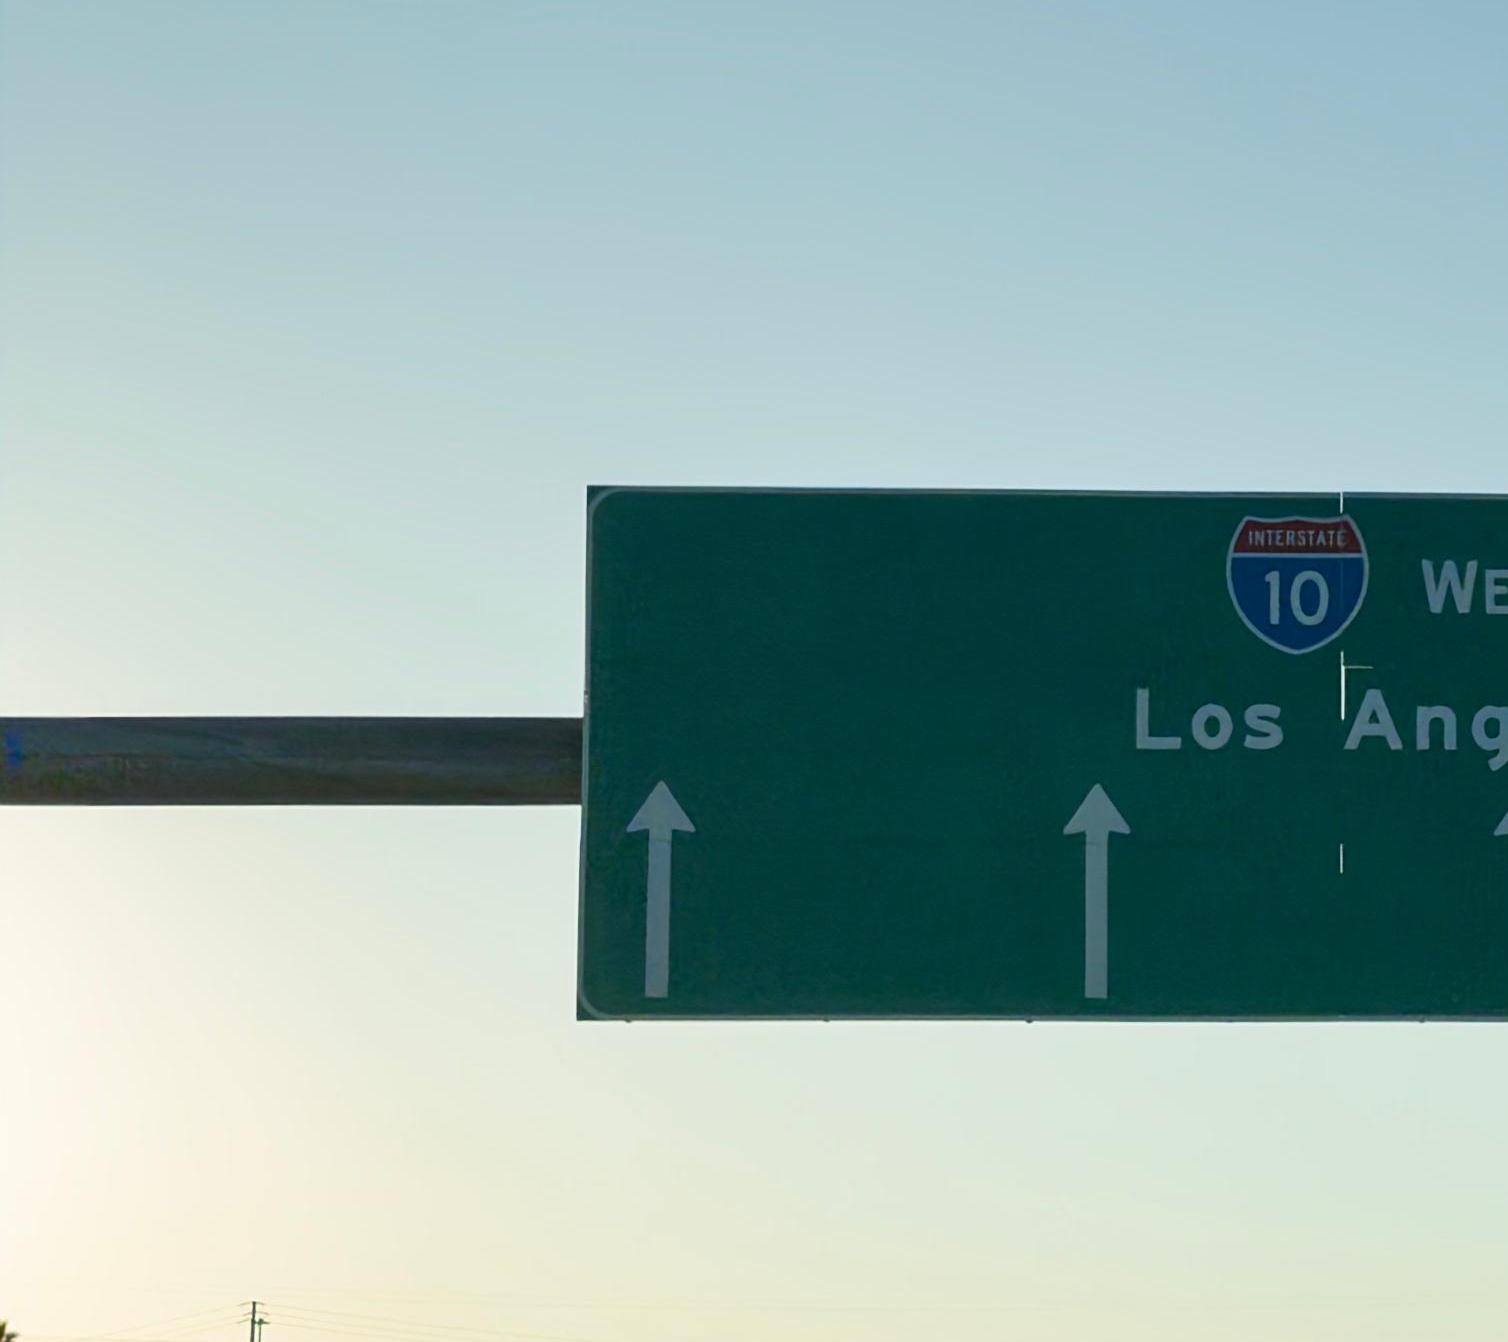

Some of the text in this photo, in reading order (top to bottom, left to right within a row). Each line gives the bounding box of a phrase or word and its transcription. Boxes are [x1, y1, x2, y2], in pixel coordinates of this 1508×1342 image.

[1248, 529, 1347, 547] INTERSTATE
[1265, 570, 1329, 626] 10
[1136, 688, 1284, 750] Los
